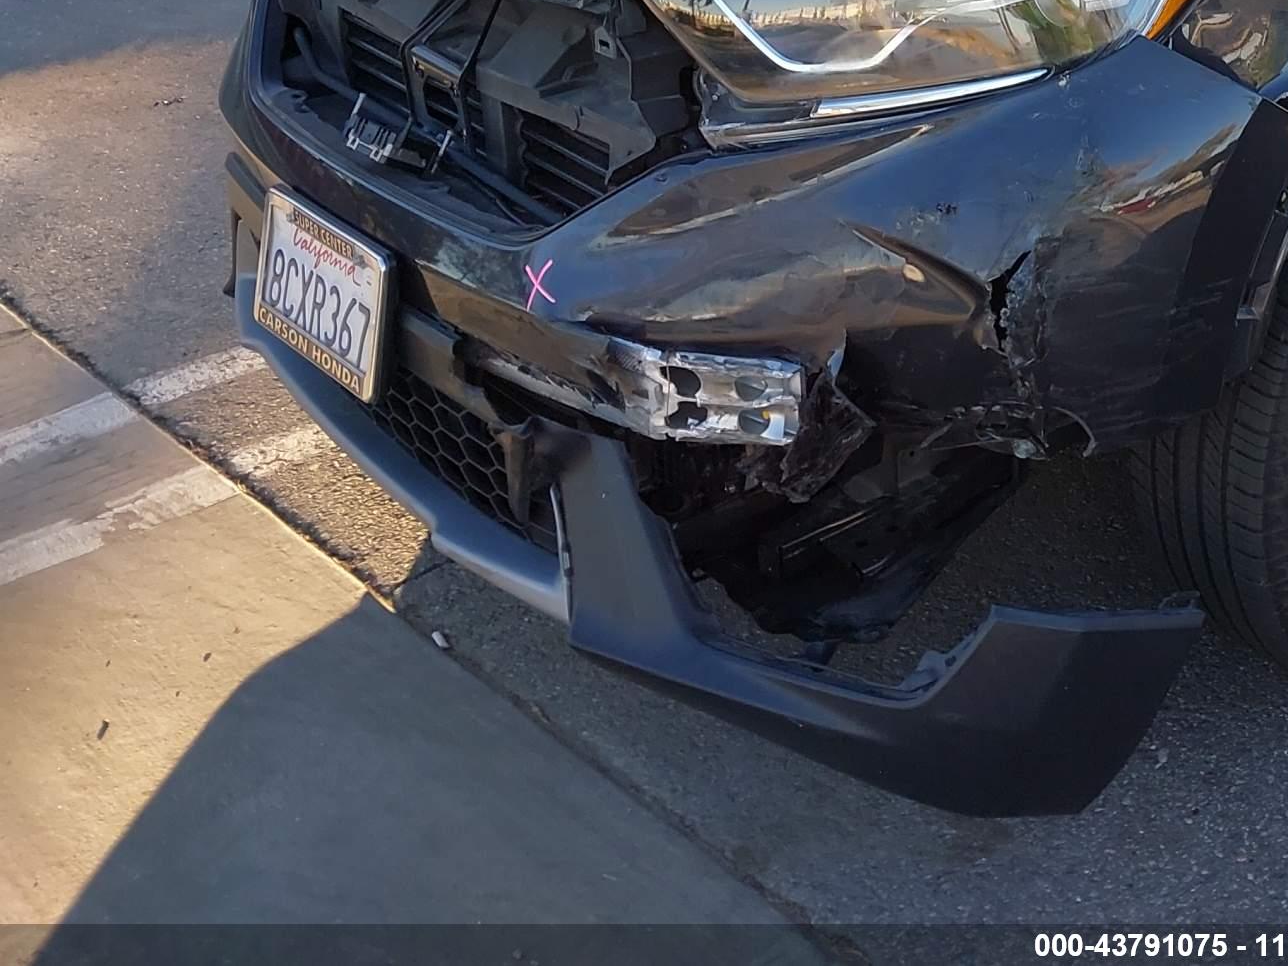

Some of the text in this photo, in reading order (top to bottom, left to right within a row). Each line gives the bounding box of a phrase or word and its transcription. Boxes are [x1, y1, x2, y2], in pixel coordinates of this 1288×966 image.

[293, 210, 354, 259] SUPER CENTER
[293, 229, 361, 286] California
[269, 248, 371, 368] 8CXR367
[259, 307, 360, 393] CARSON HONDA
